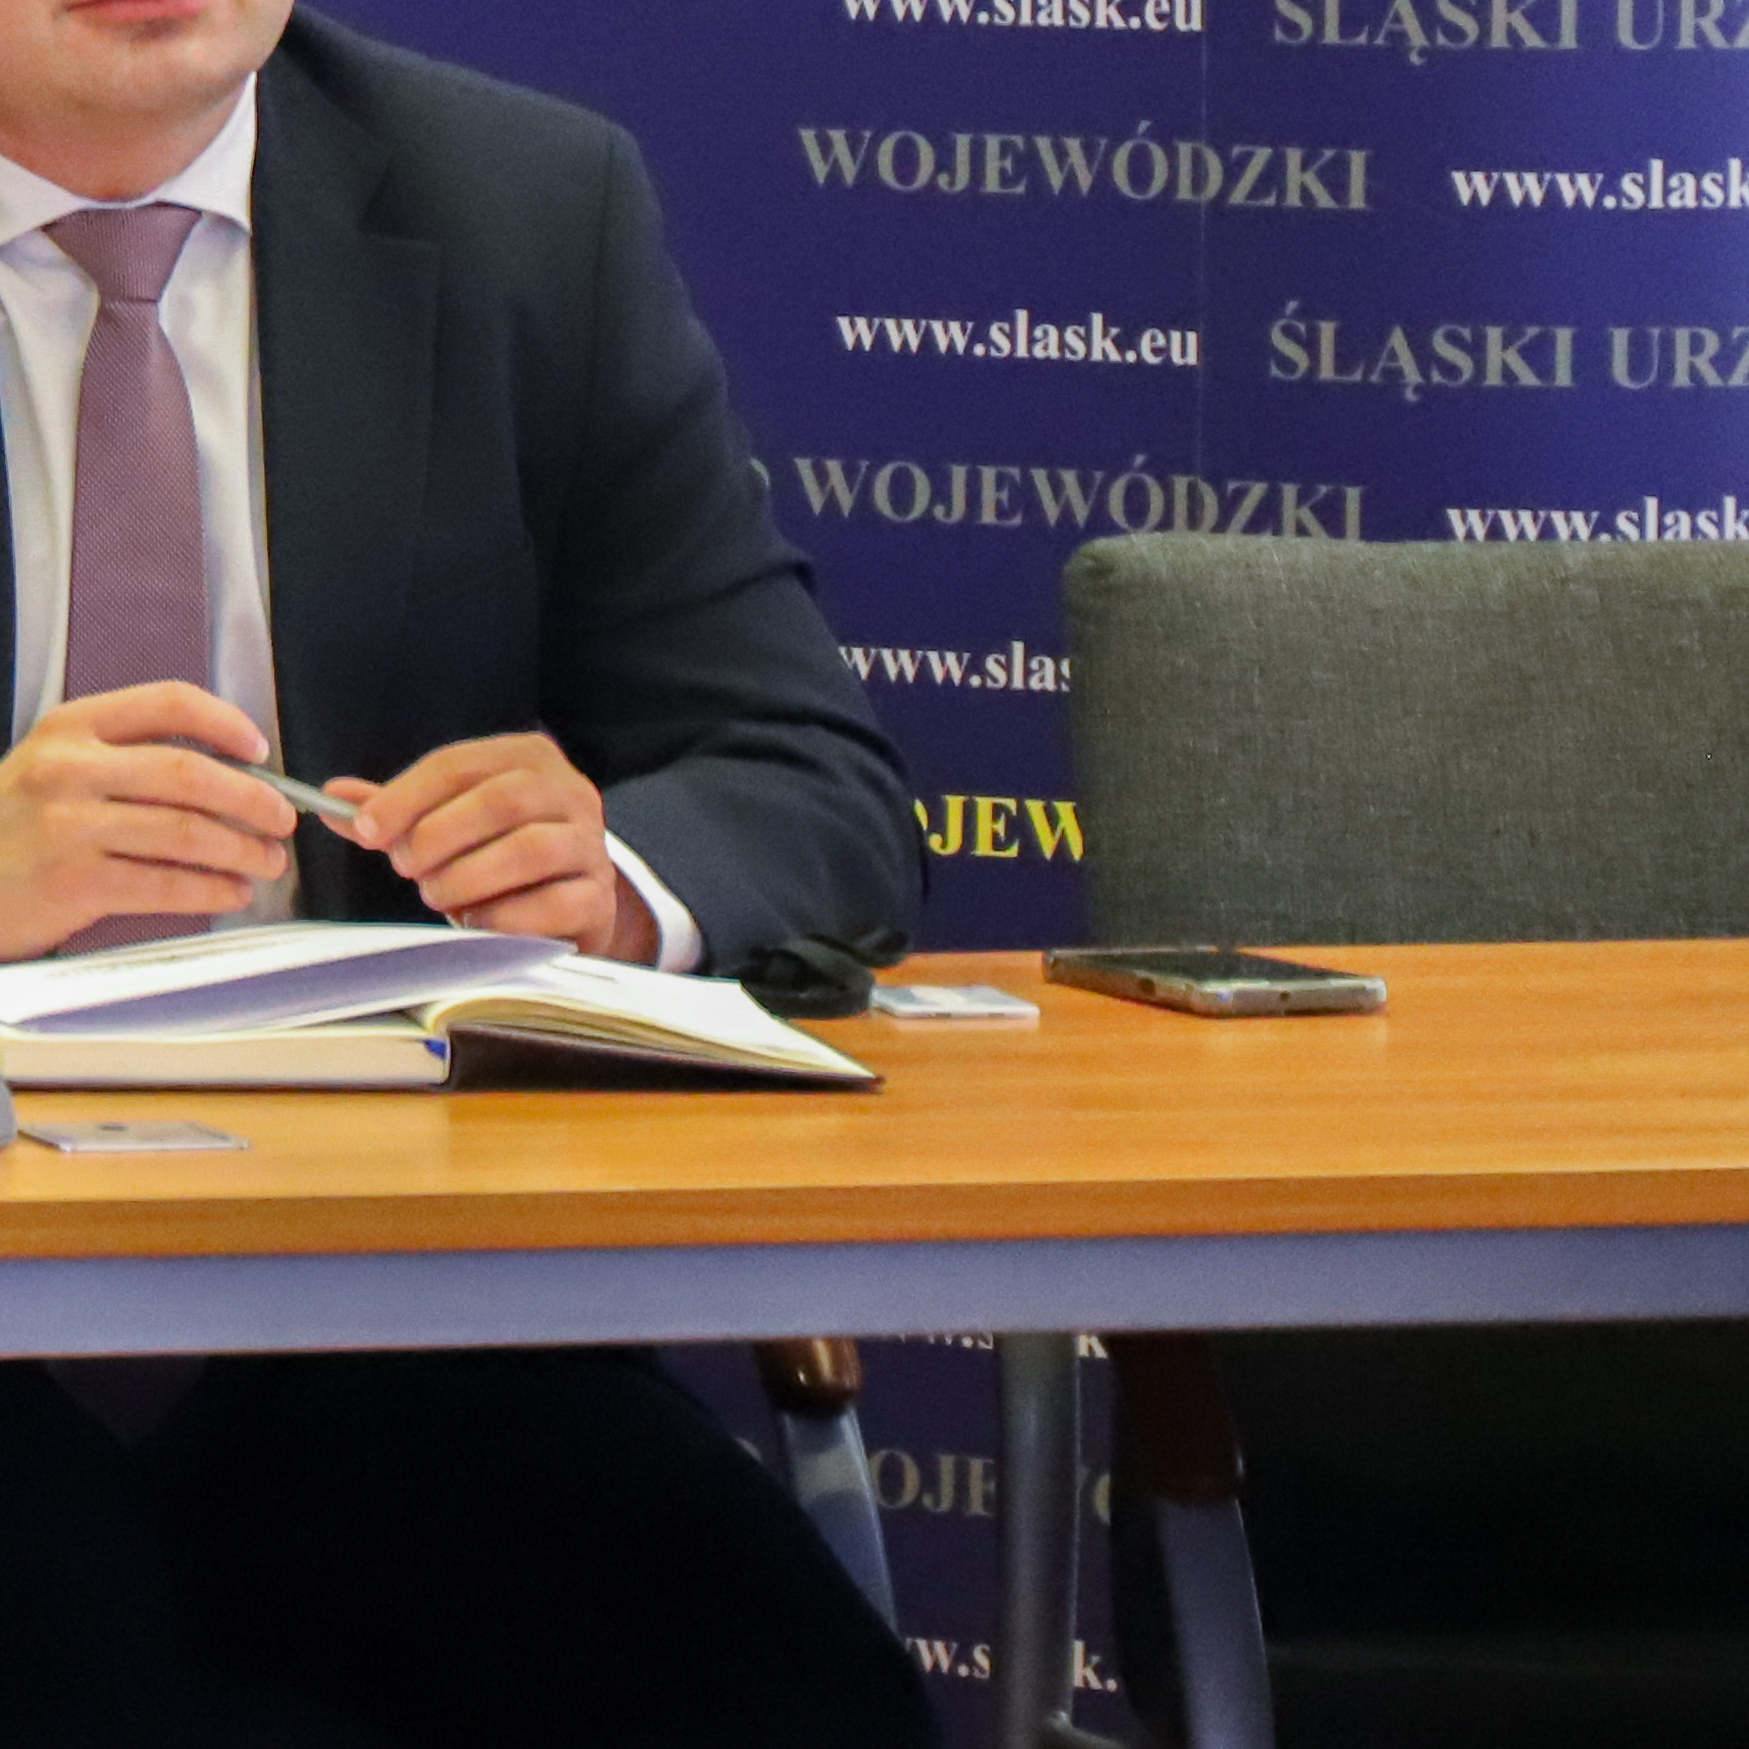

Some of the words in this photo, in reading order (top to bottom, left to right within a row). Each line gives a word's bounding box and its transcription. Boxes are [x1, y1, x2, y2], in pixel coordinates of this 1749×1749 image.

[798, 120, 1367, 210] WOJEWÓDZKI
[837, 309, 1198, 366] www.slask.eu
[1271, 301, 1576, 402] ŚLĄSKI
[794, 454, 1362, 539] WOJEWÓDZKI
